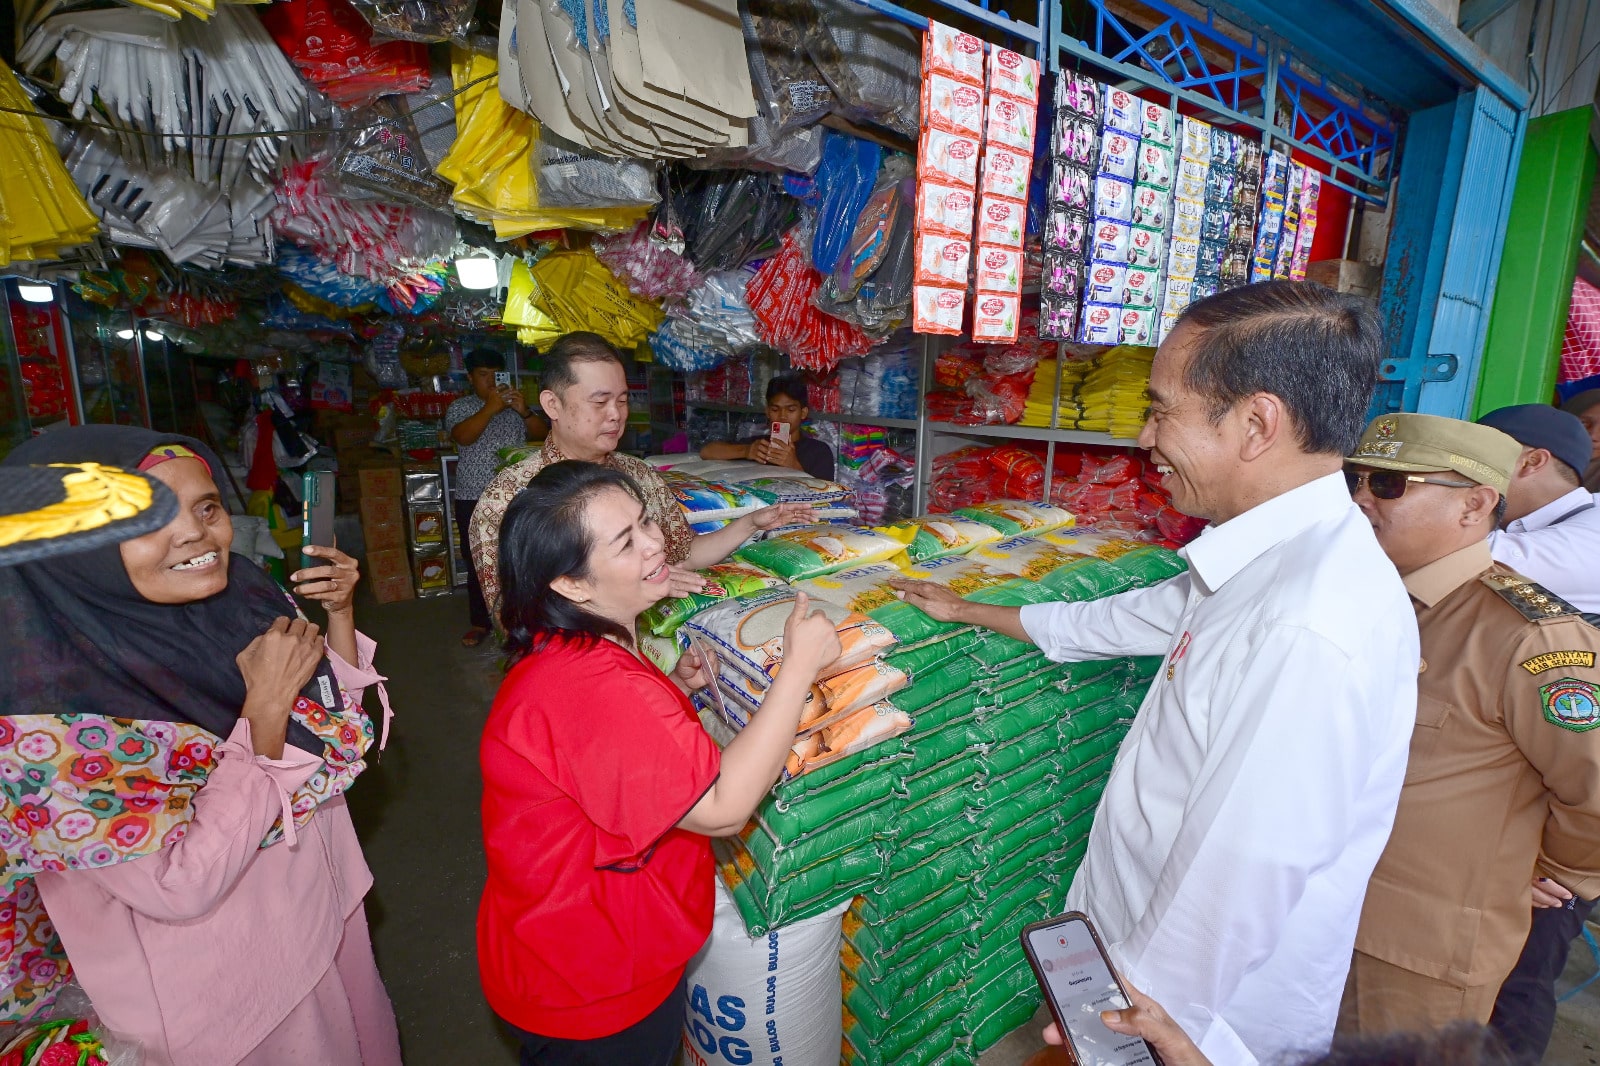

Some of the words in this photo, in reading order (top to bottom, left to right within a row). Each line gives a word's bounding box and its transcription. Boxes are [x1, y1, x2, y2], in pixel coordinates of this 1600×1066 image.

[1174, 240, 1196, 256] CLEAR
[1525, 652, 1589, 668] PEMERINTAH
[1552, 658, 1590, 667] SEKADAU
[768, 930, 779, 972] BULOG
[765, 975, 777, 1015] BULOG
[765, 1019, 781, 1053] BULOG
